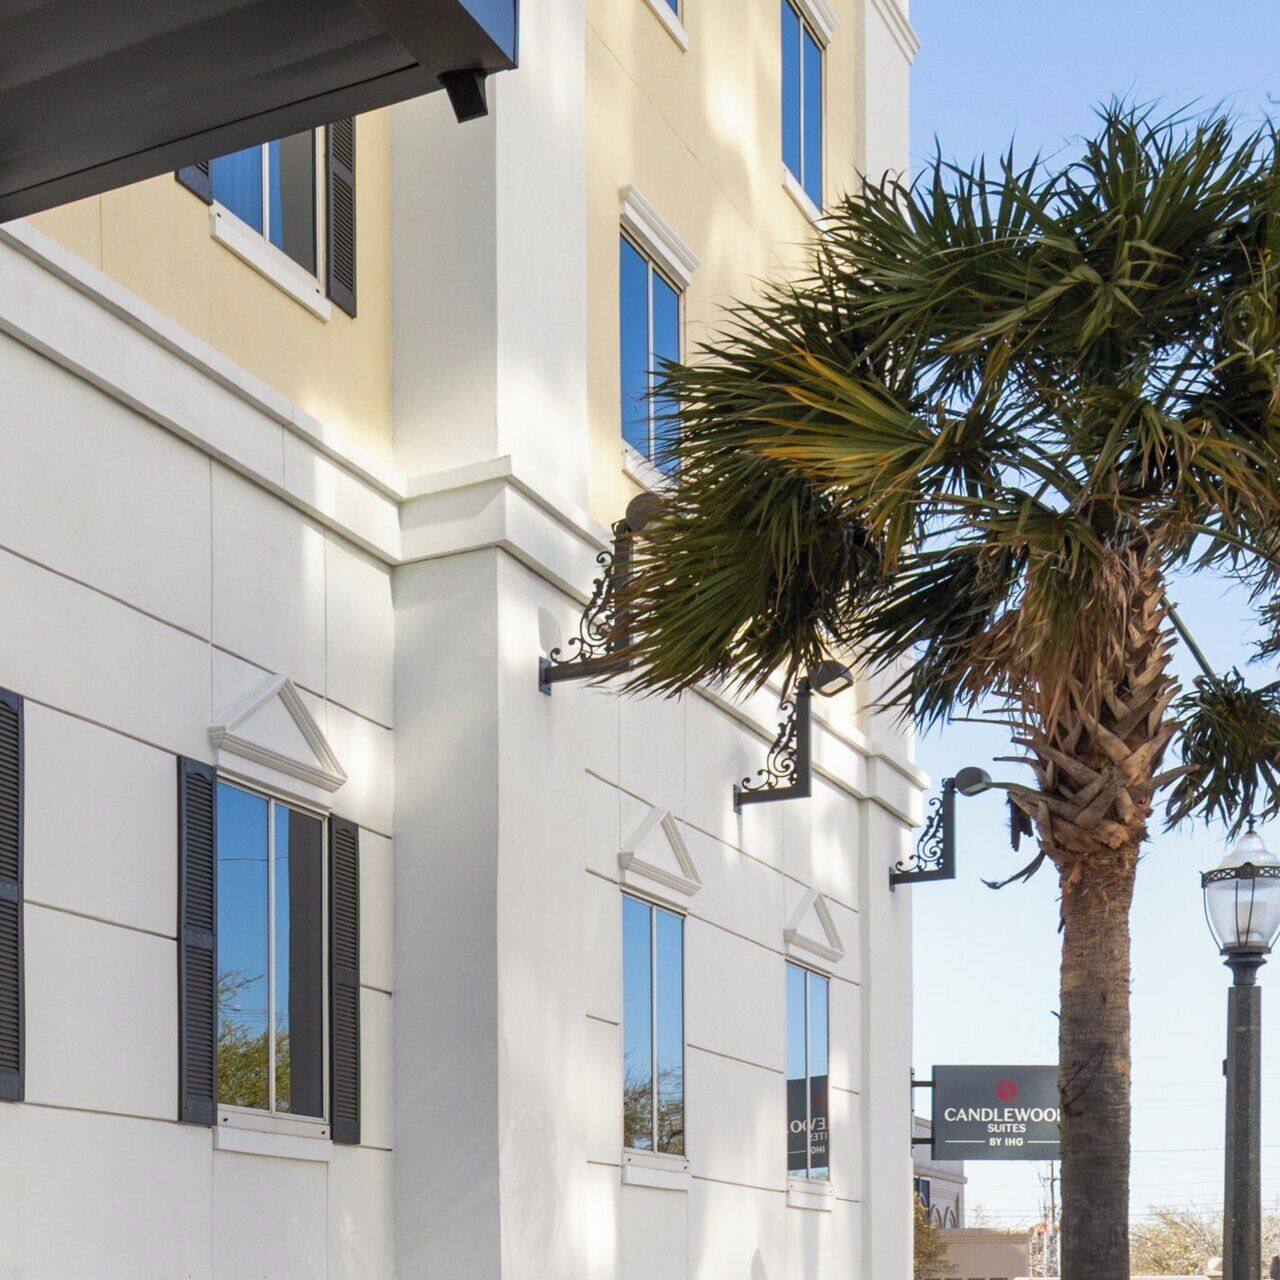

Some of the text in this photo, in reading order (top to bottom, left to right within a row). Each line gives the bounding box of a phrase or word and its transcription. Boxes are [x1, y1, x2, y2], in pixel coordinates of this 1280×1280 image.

[987, 1123, 1027, 1133] SUITES
[989, 1137, 1024, 1147] BY IHG
